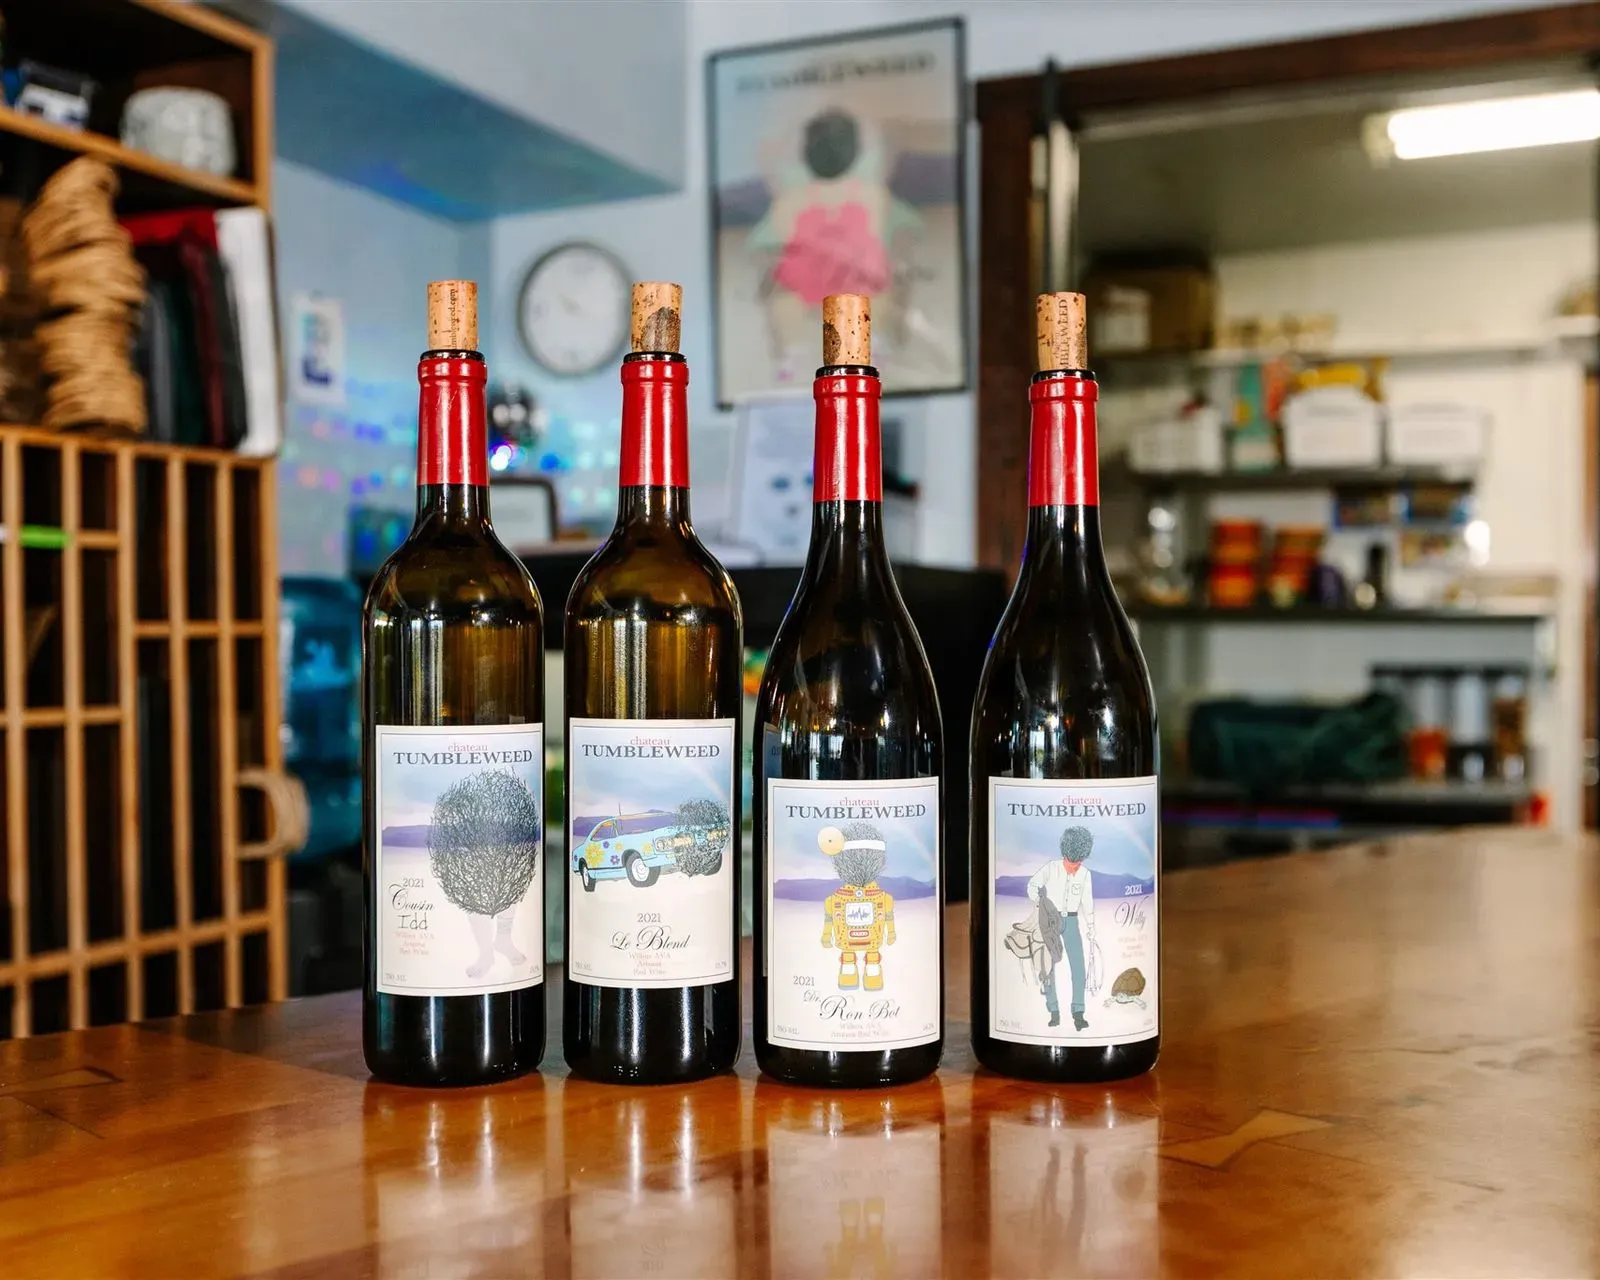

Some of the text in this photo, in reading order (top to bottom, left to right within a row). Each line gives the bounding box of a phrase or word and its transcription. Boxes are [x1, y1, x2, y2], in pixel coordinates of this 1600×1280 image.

[447, 741, 488, 752] chateau
[630, 736, 670, 746] chateau
[393, 749, 533, 765] TUMBLEWEED
[581, 744, 720, 758] TUMBLEWEED
[839, 797, 879, 807] chateau
[1062, 795, 1102, 805] chateau
[785, 804, 926, 819] TUMBLEWEED
[1007, 802, 1146, 818] TUMBLEWEED
[402, 878, 425, 888] 2021
[1124, 884, 1143, 896] 2021
[388, 883, 434, 911] Cousin
[397, 912, 428, 930] Idd
[637, 912, 662, 923] 2021
[608, 924, 691, 951] Le Blend
[793, 975, 815, 987] 2021
[819, 994, 901, 1020] Ron Bot
